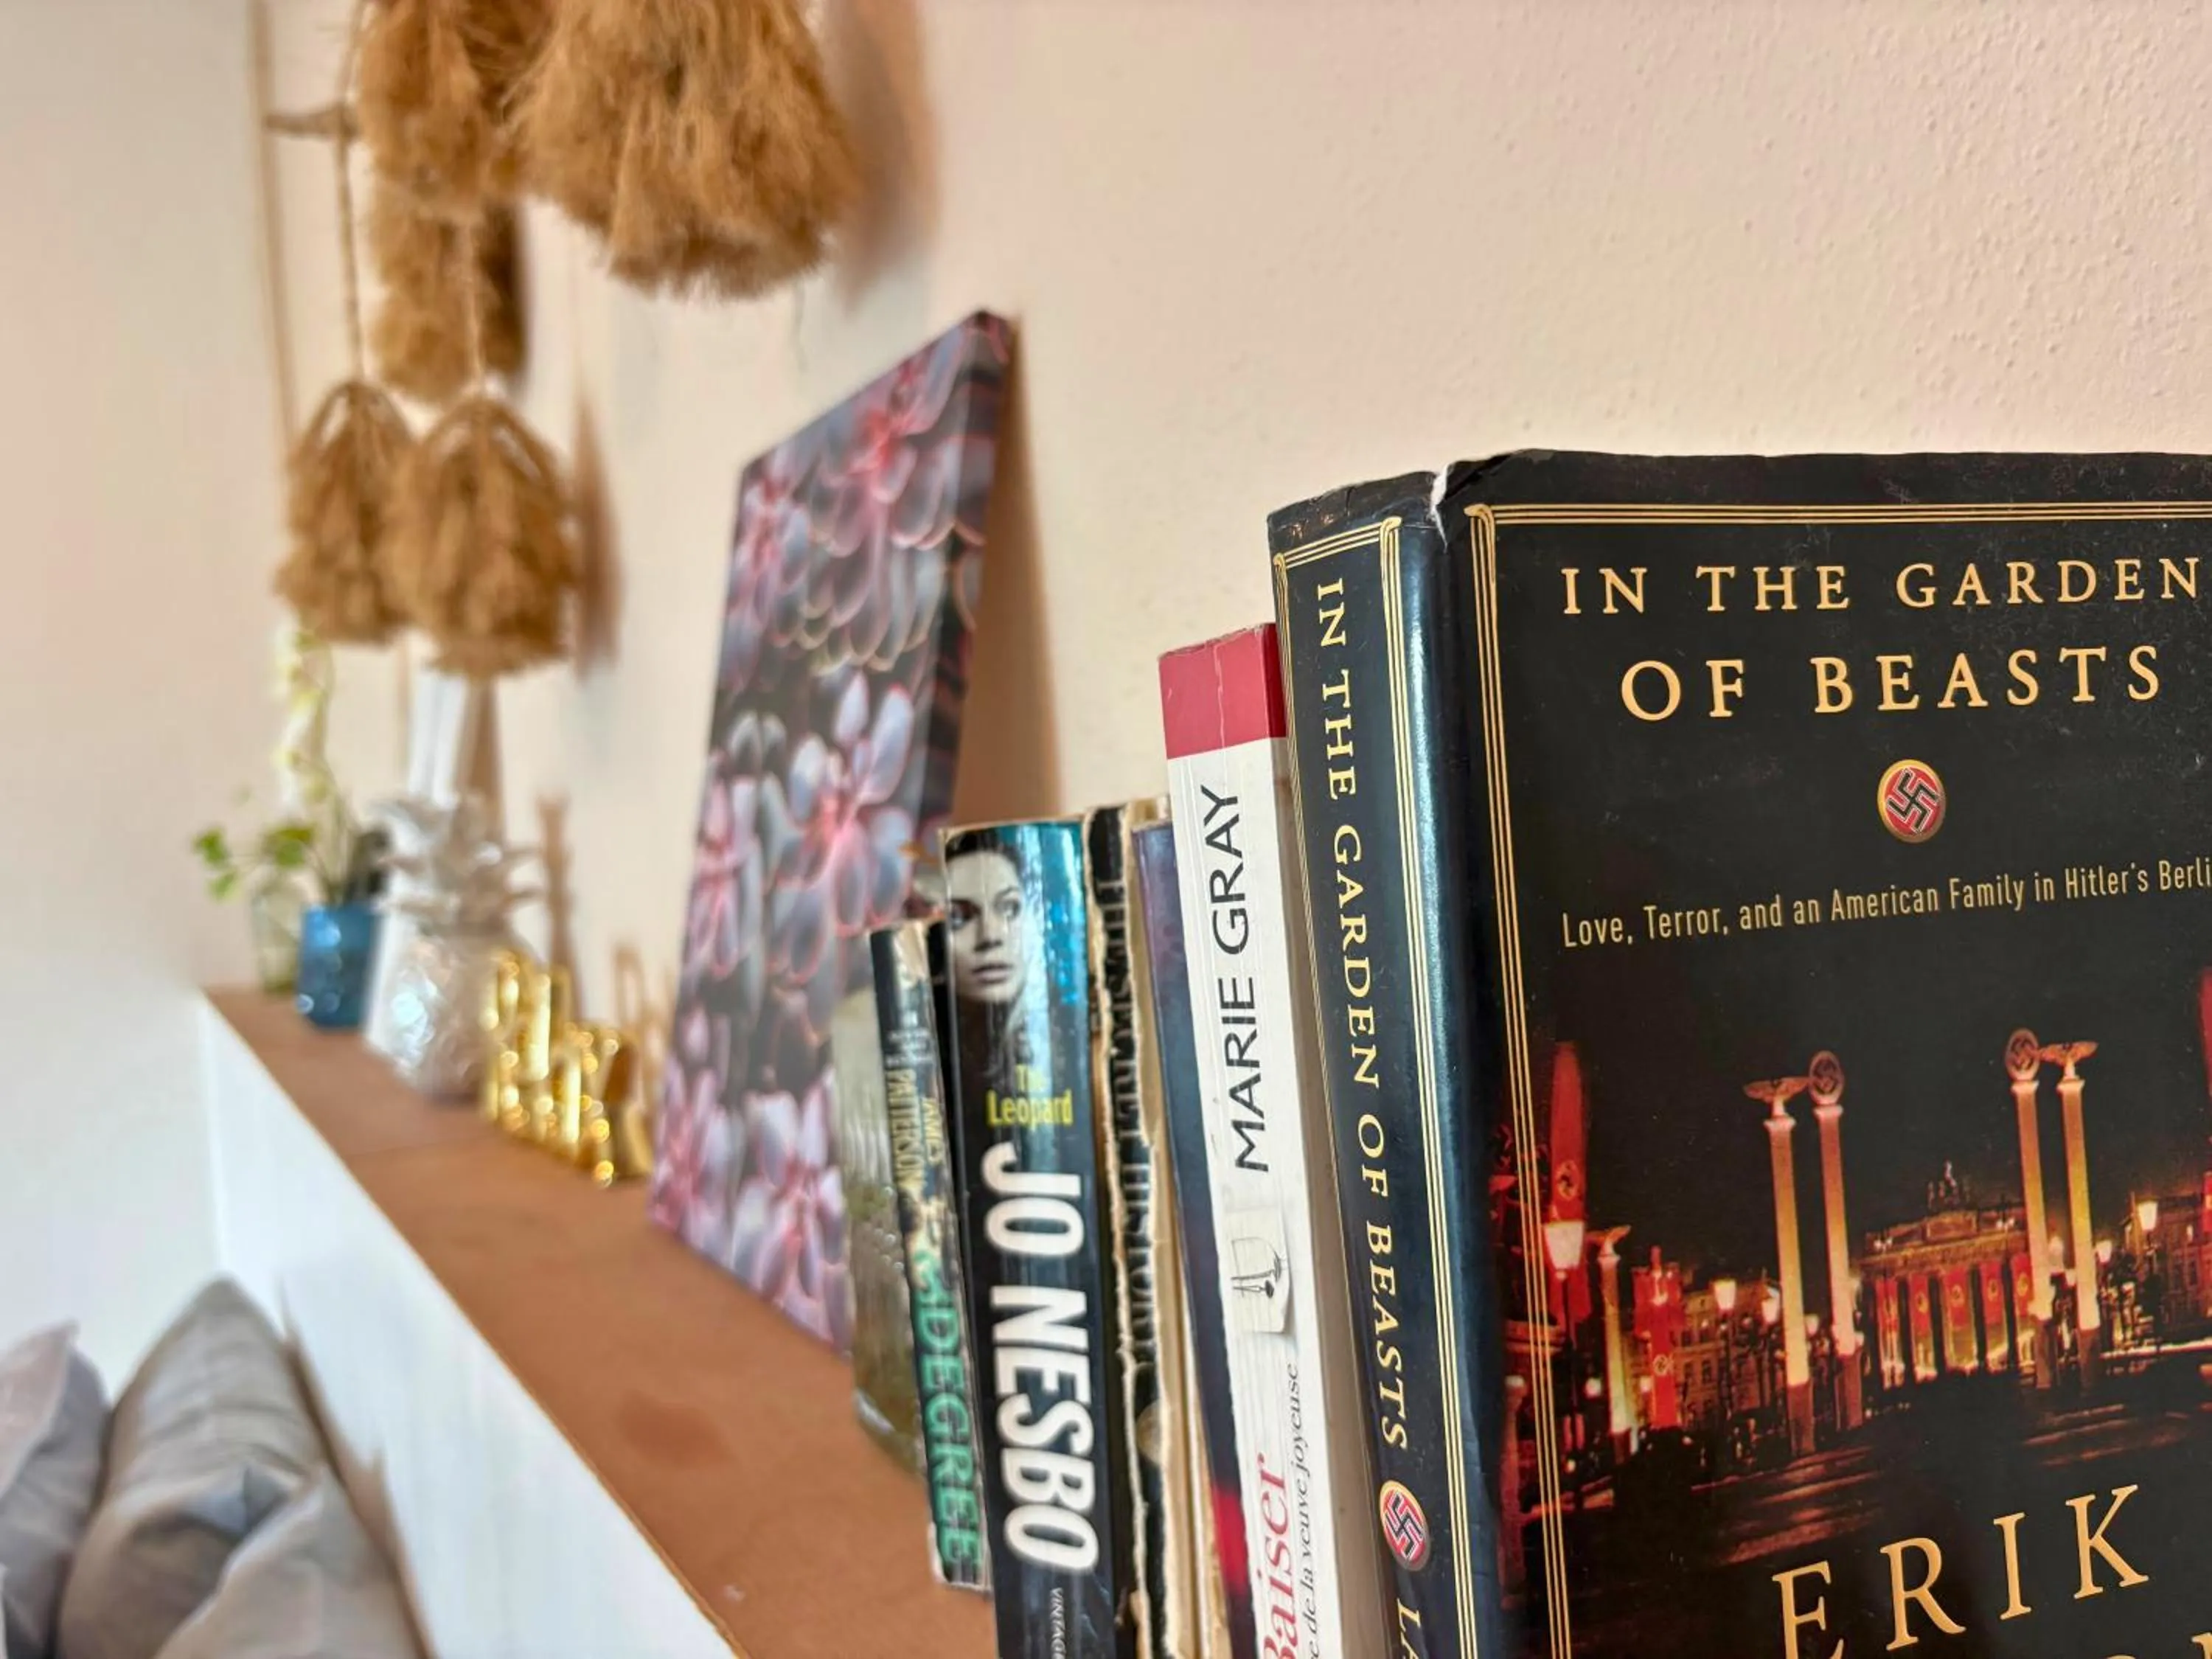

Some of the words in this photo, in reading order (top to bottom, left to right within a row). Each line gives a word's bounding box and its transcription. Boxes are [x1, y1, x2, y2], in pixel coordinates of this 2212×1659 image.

[1317, 577, 1347, 647] IN
[1561, 567, 1648, 614] IN
[1695, 566, 1850, 612] THE
[1896, 557, 2200, 609] GARDEN
[1322, 669, 1357, 800] THE
[1621, 658, 1745, 721] OF
[1809, 645, 2160, 714] BEASTS
[1200, 785, 1249, 955] GRAY
[1562, 912, 1633, 948] Love,
[1644, 905, 1729, 939] Terror,
[1739, 894, 1783, 931] and
[1793, 899, 1820, 925] an
[1831, 884, 1940, 922] American
[1949, 874, 2025, 912] Family
[2034, 872, 2056, 902] in
[2065, 862, 2149, 900] Hitler's
[1333, 824, 1380, 1089] GARDEN
[986, 1089, 1074, 1133] Leopard
[1217, 978, 1269, 1173] MARIE
[981, 1142, 1085, 1256] JO
[1357, 1113, 1389, 1198] OF
[1366, 1220, 1408, 1450] BEASTS
[915, 1308, 983, 1568] DEGREE
[990, 1284, 1099, 1572] NESBO
[1286, 1363, 1310, 1478] joyeuse
[1296, 1480, 1313, 1558] veuve
[1772, 1484, 2149, 1659] ERIK
